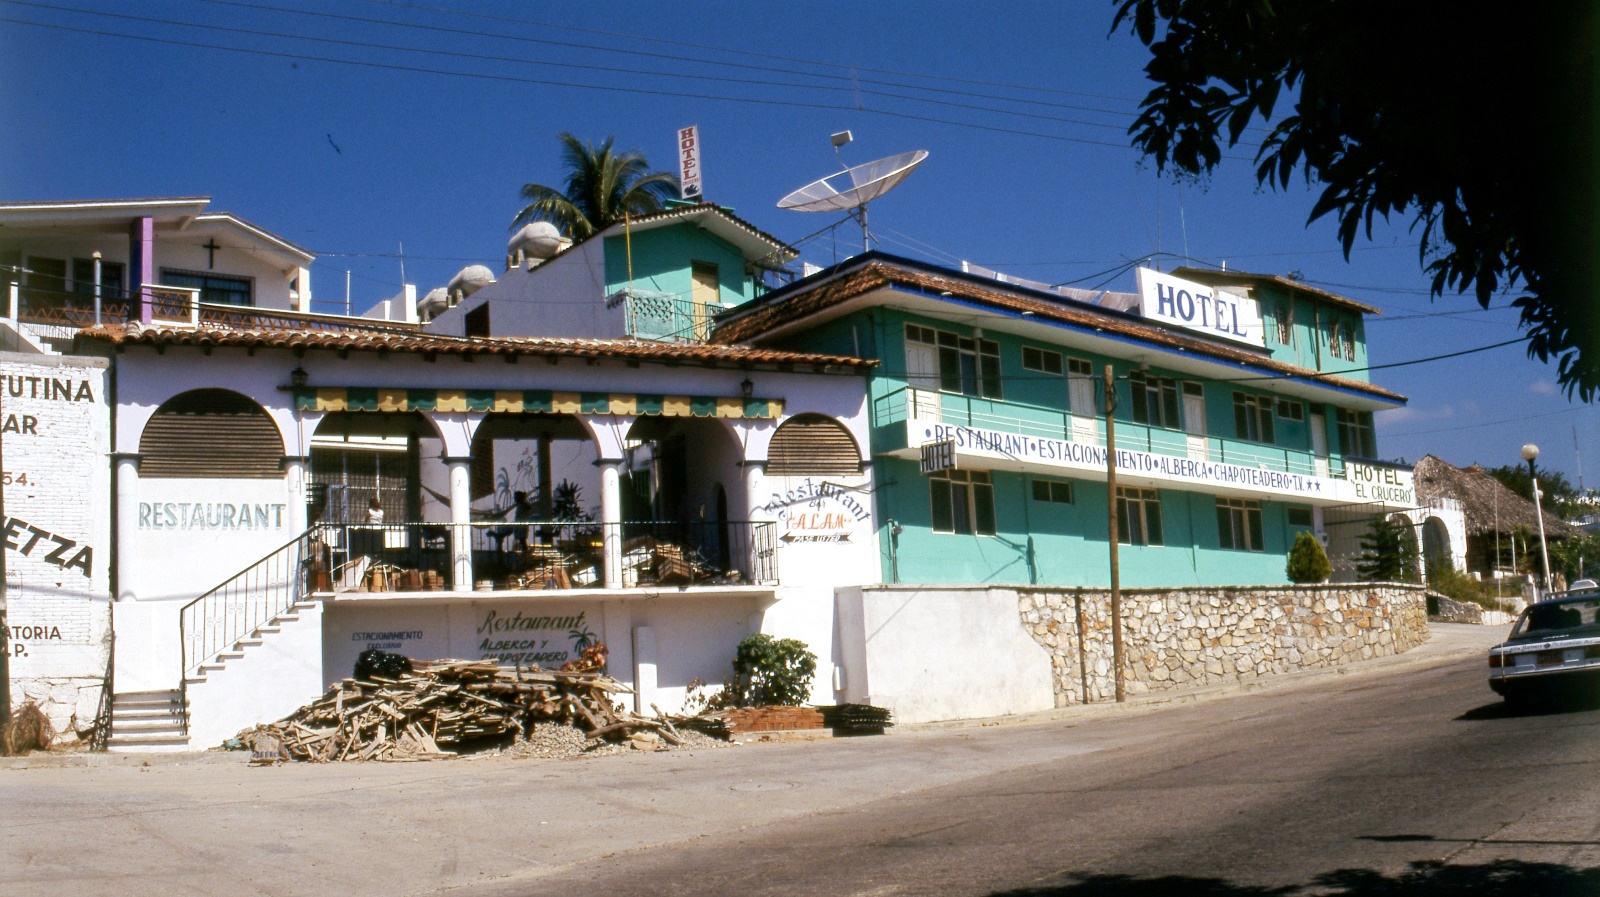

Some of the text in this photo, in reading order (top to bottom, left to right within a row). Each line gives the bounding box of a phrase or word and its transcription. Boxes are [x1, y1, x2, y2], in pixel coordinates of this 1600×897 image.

[681, 127, 697, 180] HOTEL
[1156, 282, 1248, 338] HOTEL
[920, 441, 955, 472] HOTEL
[934, 424, 1029, 455] RESTAURANT
[1160, 457, 1208, 479] ALBERCA
[1214, 464, 1289, 489] CHAPOTEADERO
[1354, 463, 1404, 486] HOTEL
[764, 477, 871, 521] Restaurant
[138, 502, 286, 530] RESTAURANT
[352, 631, 423, 641] ESTACIONAMIENTO
[477, 610, 586, 635] Restaurant
[367, 642, 402, 650] EXCLUSIVO
[480, 637, 549, 651] ALBERCA Y
